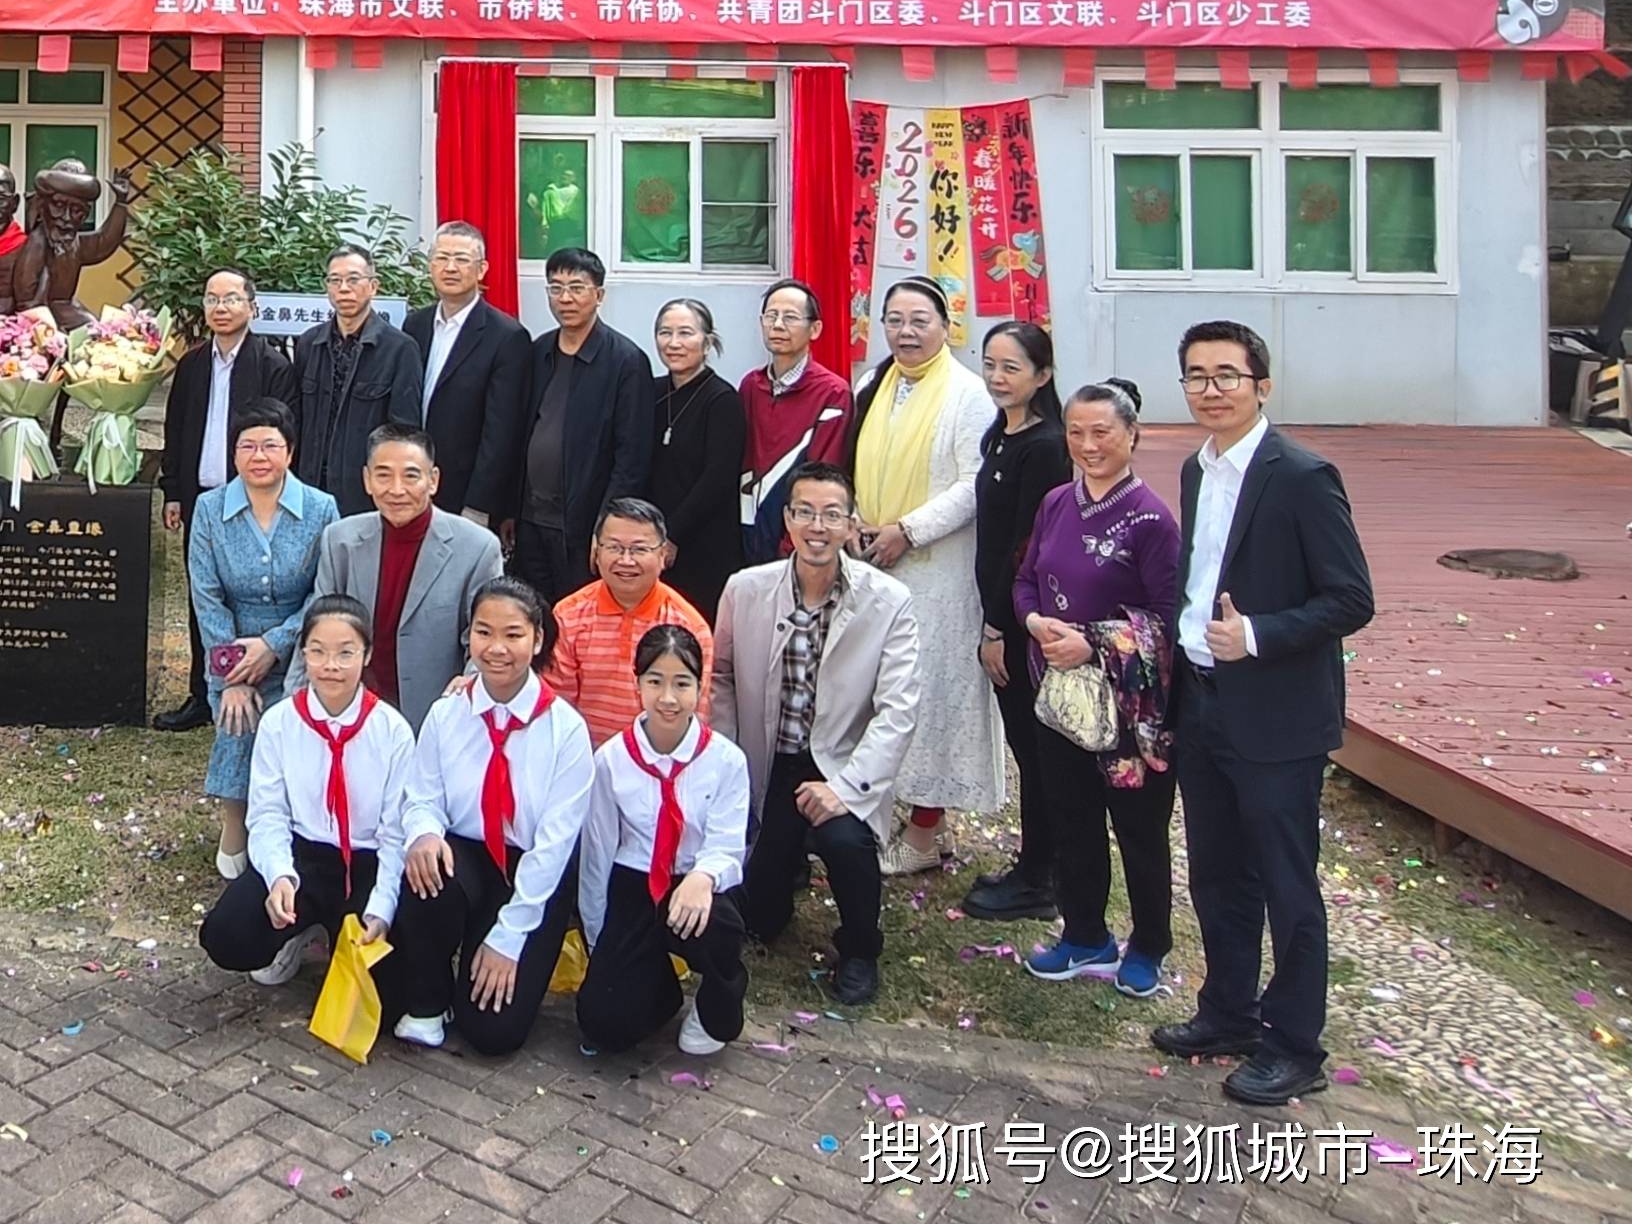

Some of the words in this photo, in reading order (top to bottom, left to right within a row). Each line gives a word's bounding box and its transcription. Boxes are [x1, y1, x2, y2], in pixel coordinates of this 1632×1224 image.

[894, 121, 923, 239] 2026
[973, 149, 999, 240] 春暖花开
[1003, 111, 1037, 224] 新年快乐
